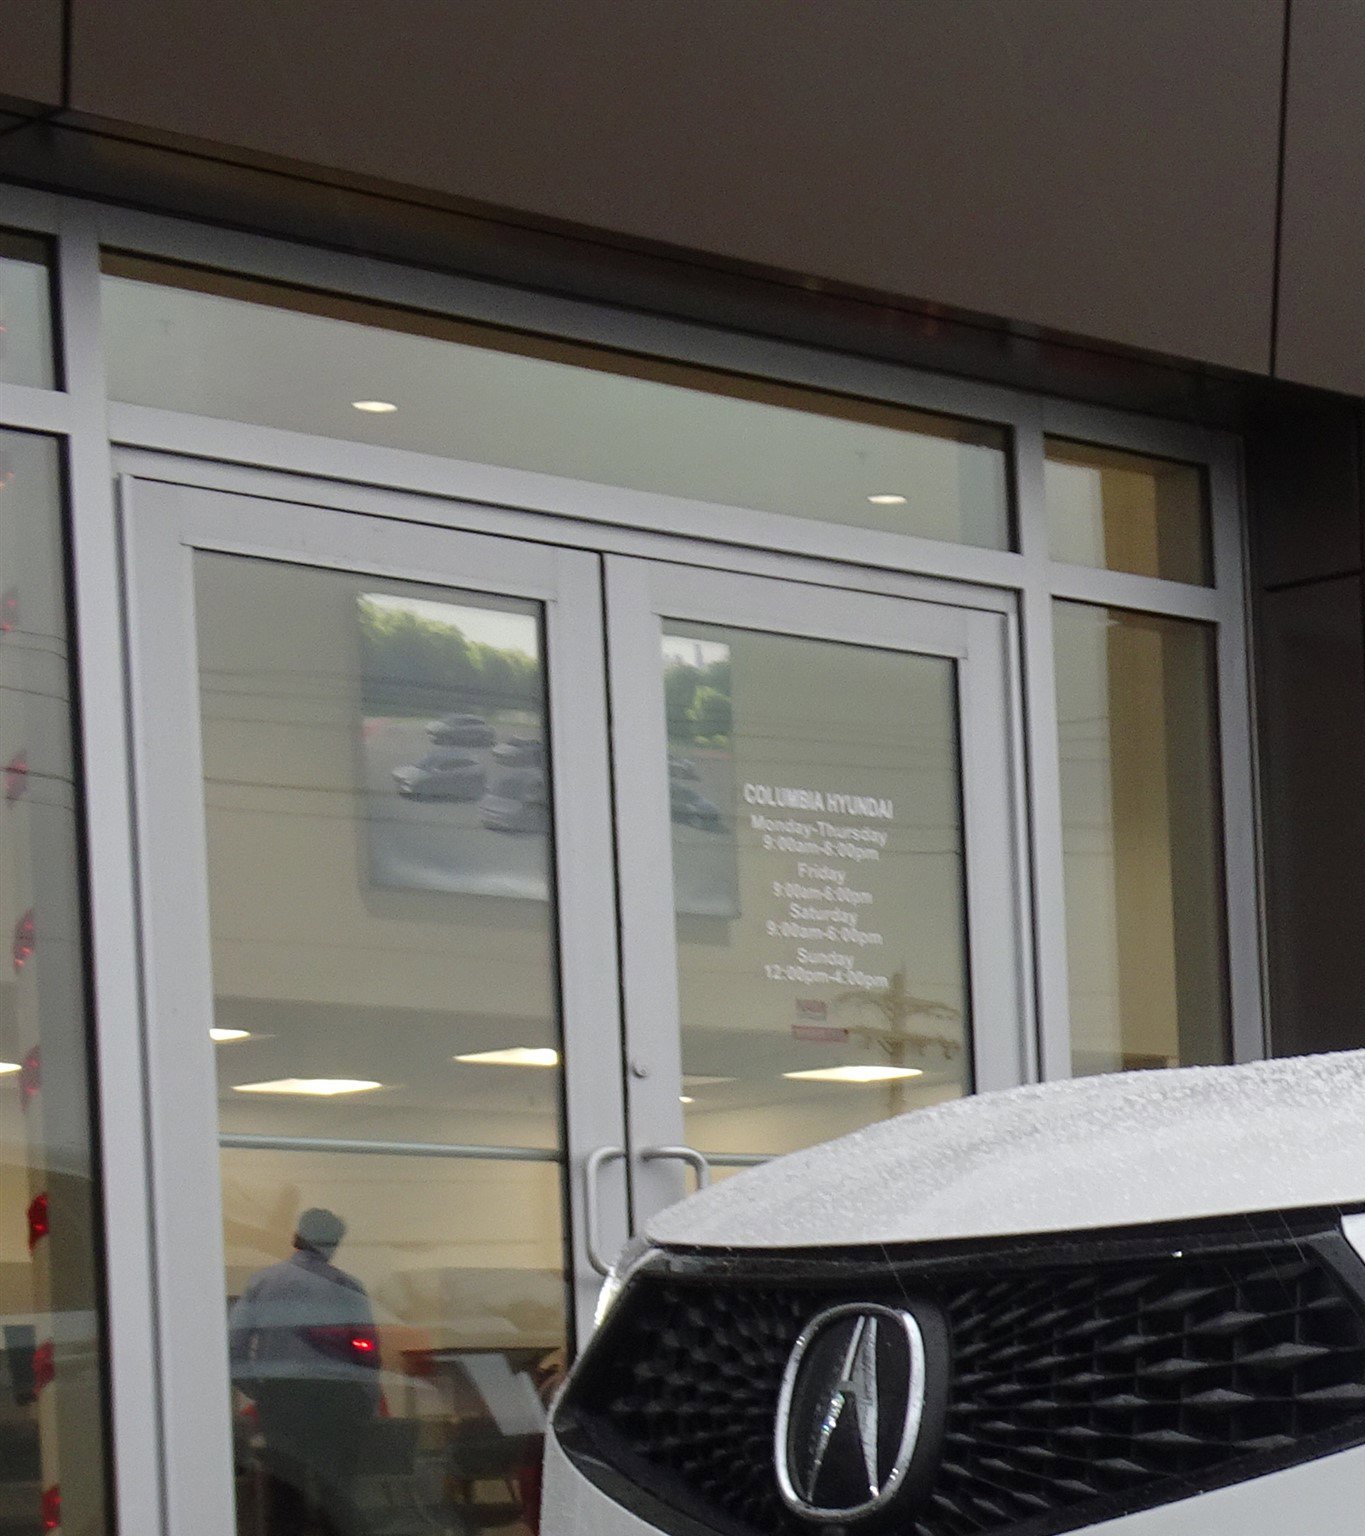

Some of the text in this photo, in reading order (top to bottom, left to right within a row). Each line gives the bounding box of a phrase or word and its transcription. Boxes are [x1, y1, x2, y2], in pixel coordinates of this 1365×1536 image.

[743, 782, 894, 820] COLUMBIA HYUNDAI
[750, 813, 888, 847] Monday-Thursday
[797, 861, 847, 886] Friday
[789, 902, 858, 928] Saturday
[796, 946, 855, 975] Sunday
